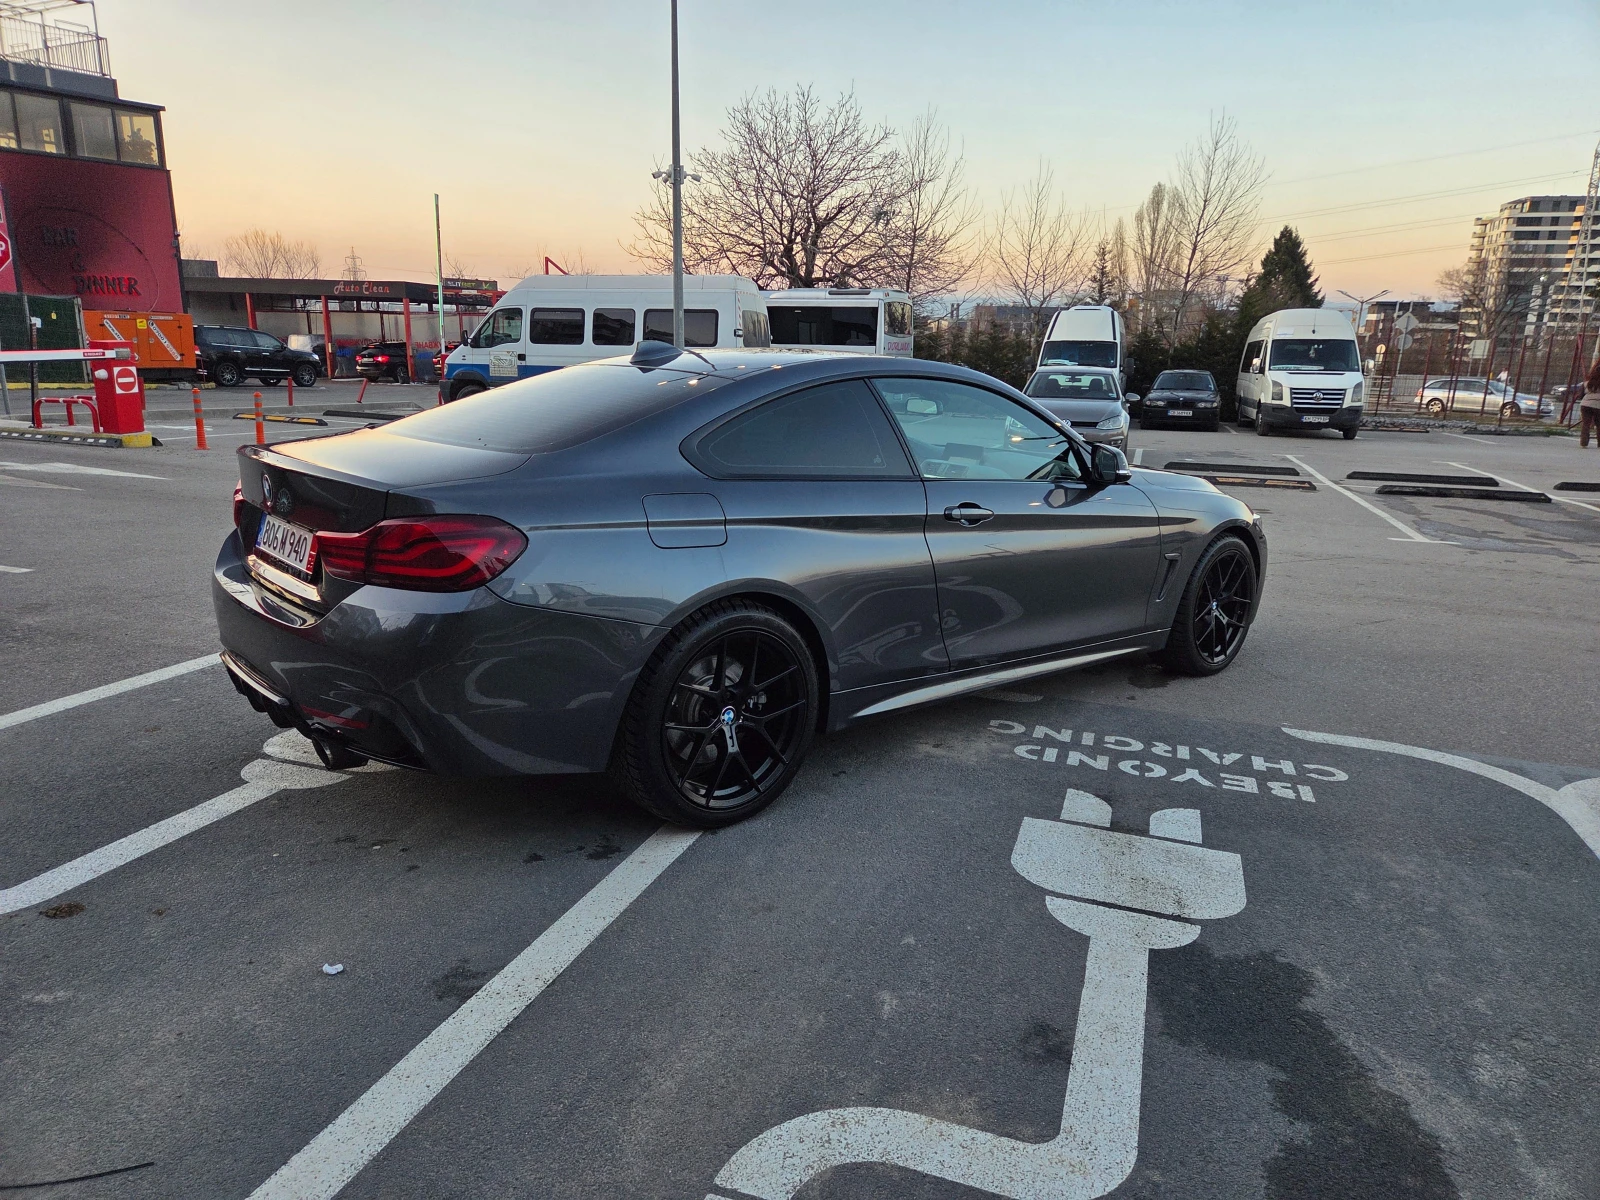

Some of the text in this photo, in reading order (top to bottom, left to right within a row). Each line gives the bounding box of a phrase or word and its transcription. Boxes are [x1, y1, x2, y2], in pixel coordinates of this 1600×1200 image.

[73, 275, 142, 296] DINNER
[334, 281, 390, 294] Auto Clean
[986, 719, 1350, 783] CHARGING
[1014, 745, 1316, 803] BEYOND
